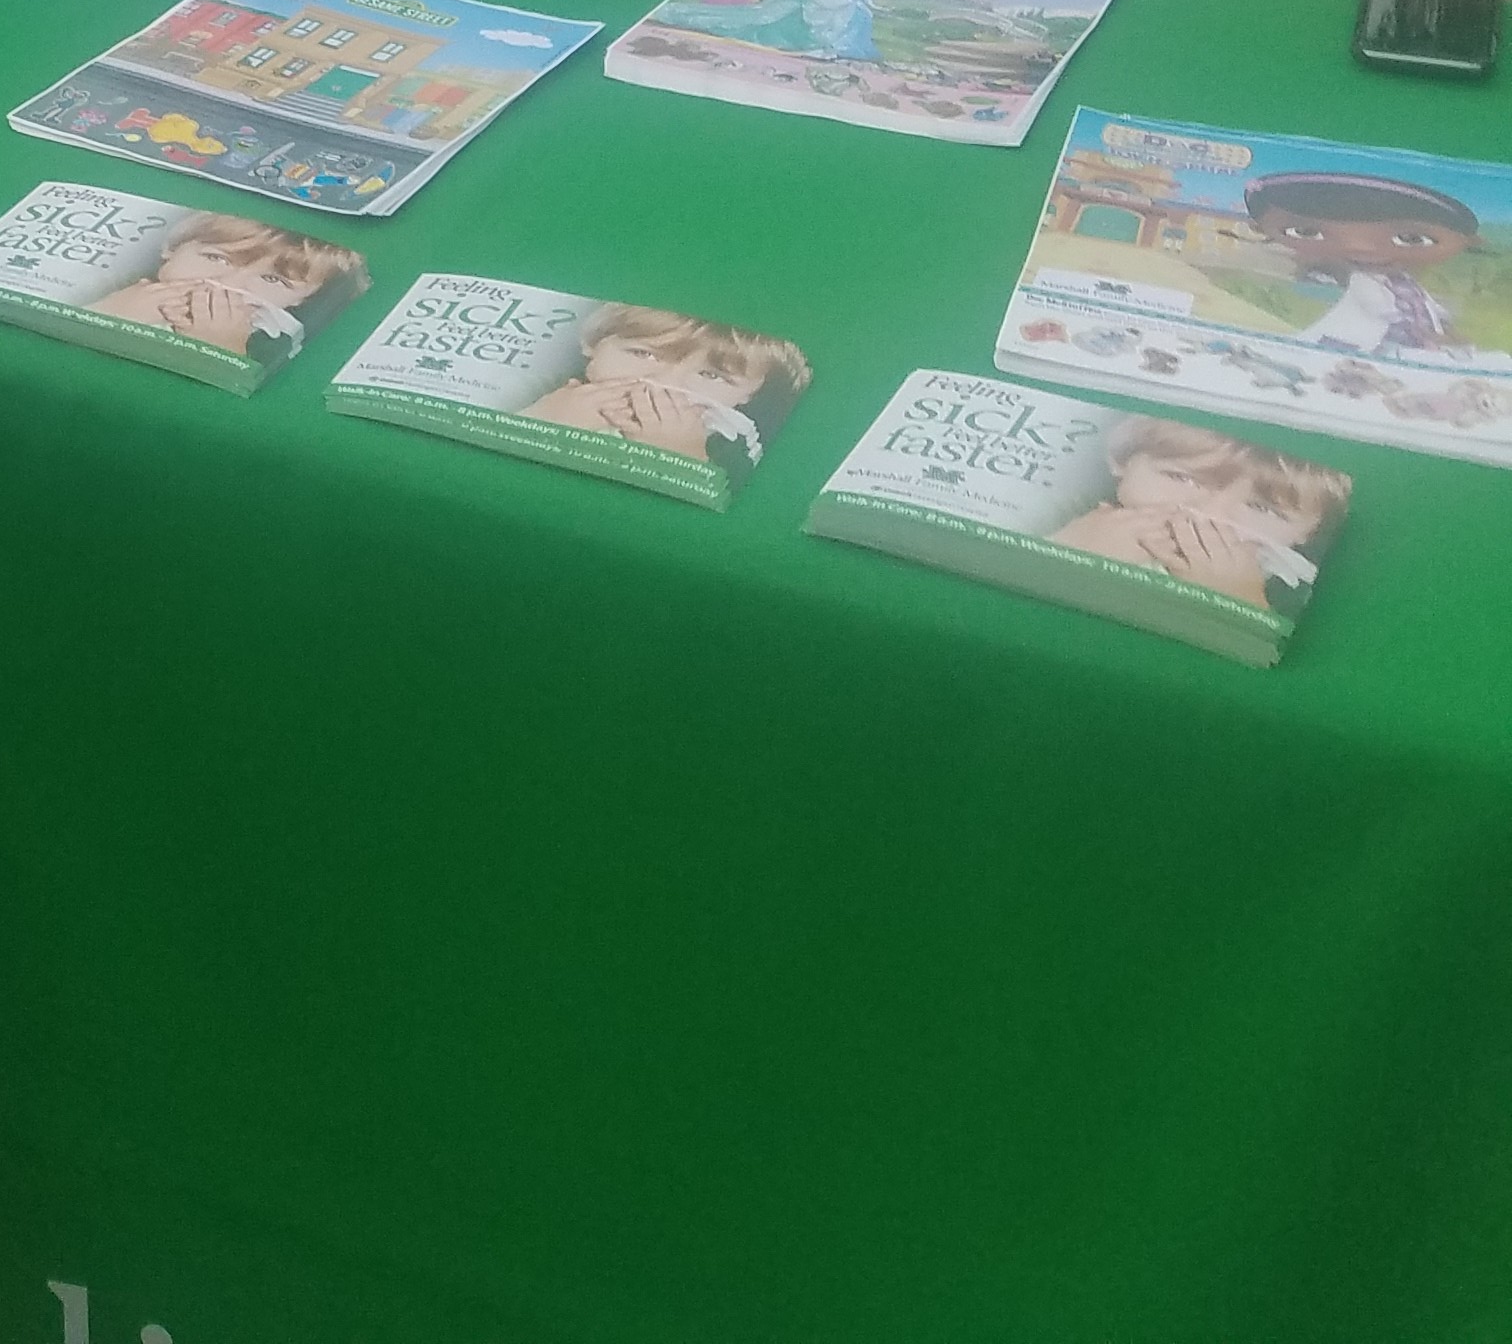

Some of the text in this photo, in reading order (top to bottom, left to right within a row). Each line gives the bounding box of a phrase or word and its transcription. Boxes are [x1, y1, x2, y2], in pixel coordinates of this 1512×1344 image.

[42, 186, 117, 208] Feeling
[15, 200, 167, 242] sick?
[426, 276, 513, 303] Feeling
[406, 292, 577, 340] sick?
[478, 326, 537, 348] better
[199, 346, 250, 370] Saturday
[380, 321, 535, 370] faster.
[903, 393, 1099, 454] sick?
[565, 429, 579, 440] 10
[659, 453, 717, 480] Saturday
[882, 424, 1055, 487] faster.
